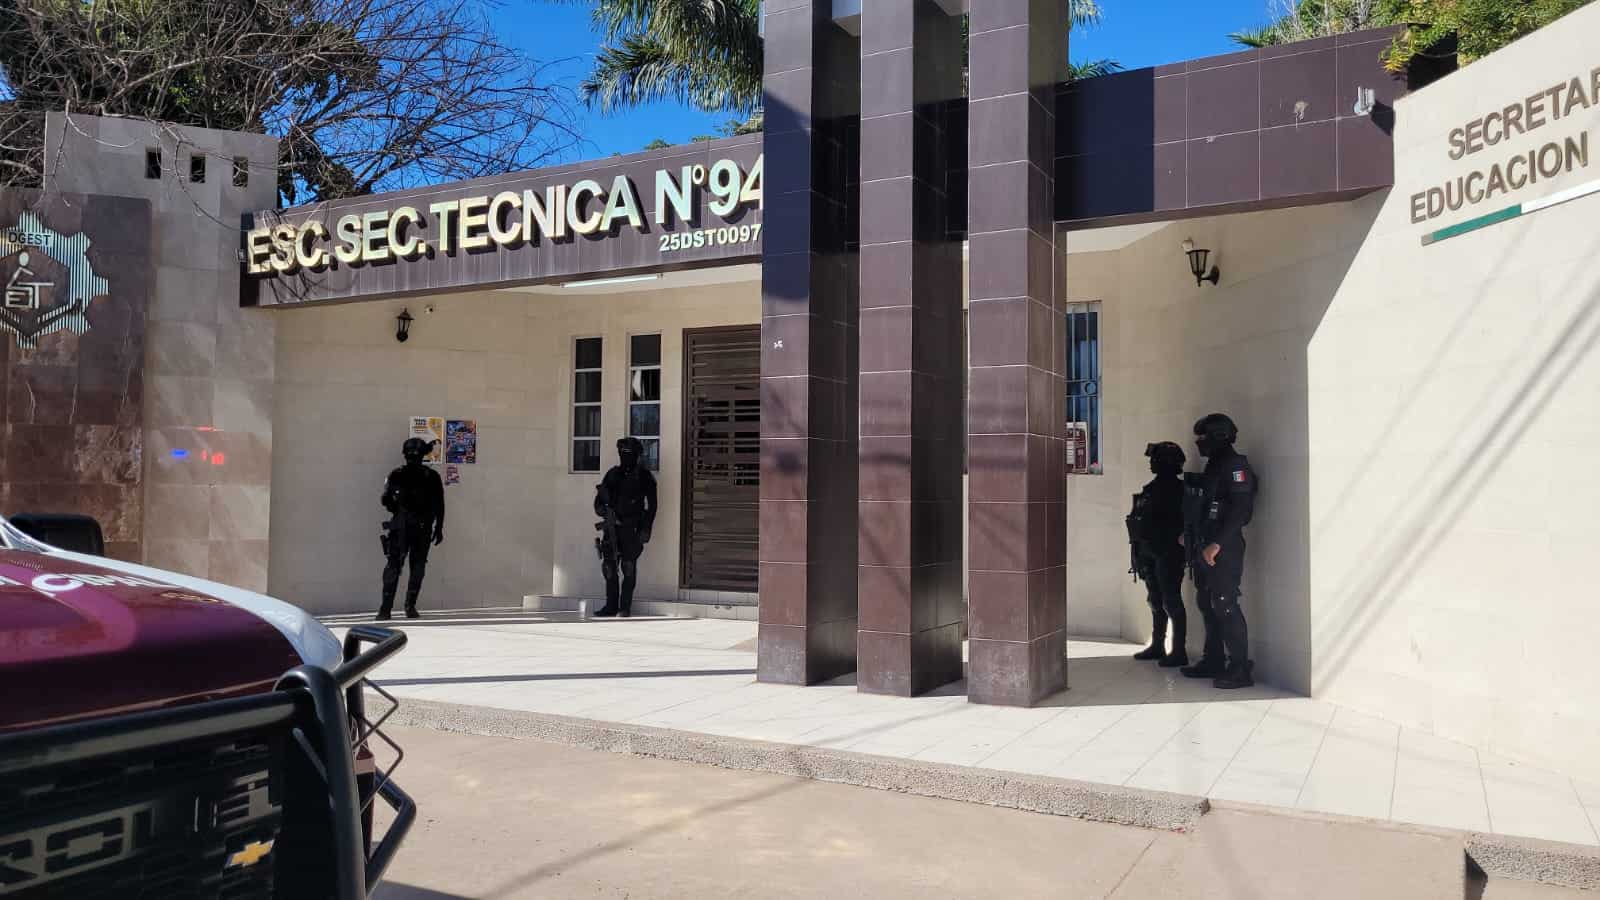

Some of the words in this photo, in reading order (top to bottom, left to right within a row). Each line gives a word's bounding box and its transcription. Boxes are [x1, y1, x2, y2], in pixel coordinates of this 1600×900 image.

[1410, 130, 1588, 224] EDUCACION
[7, 231, 52, 246] DGEST
[247, 220, 330, 274] ESC.
[334, 206, 427, 264] SEC.
[430, 174, 642, 252] TECNICA
[659, 223, 762, 252] 25DST0097
